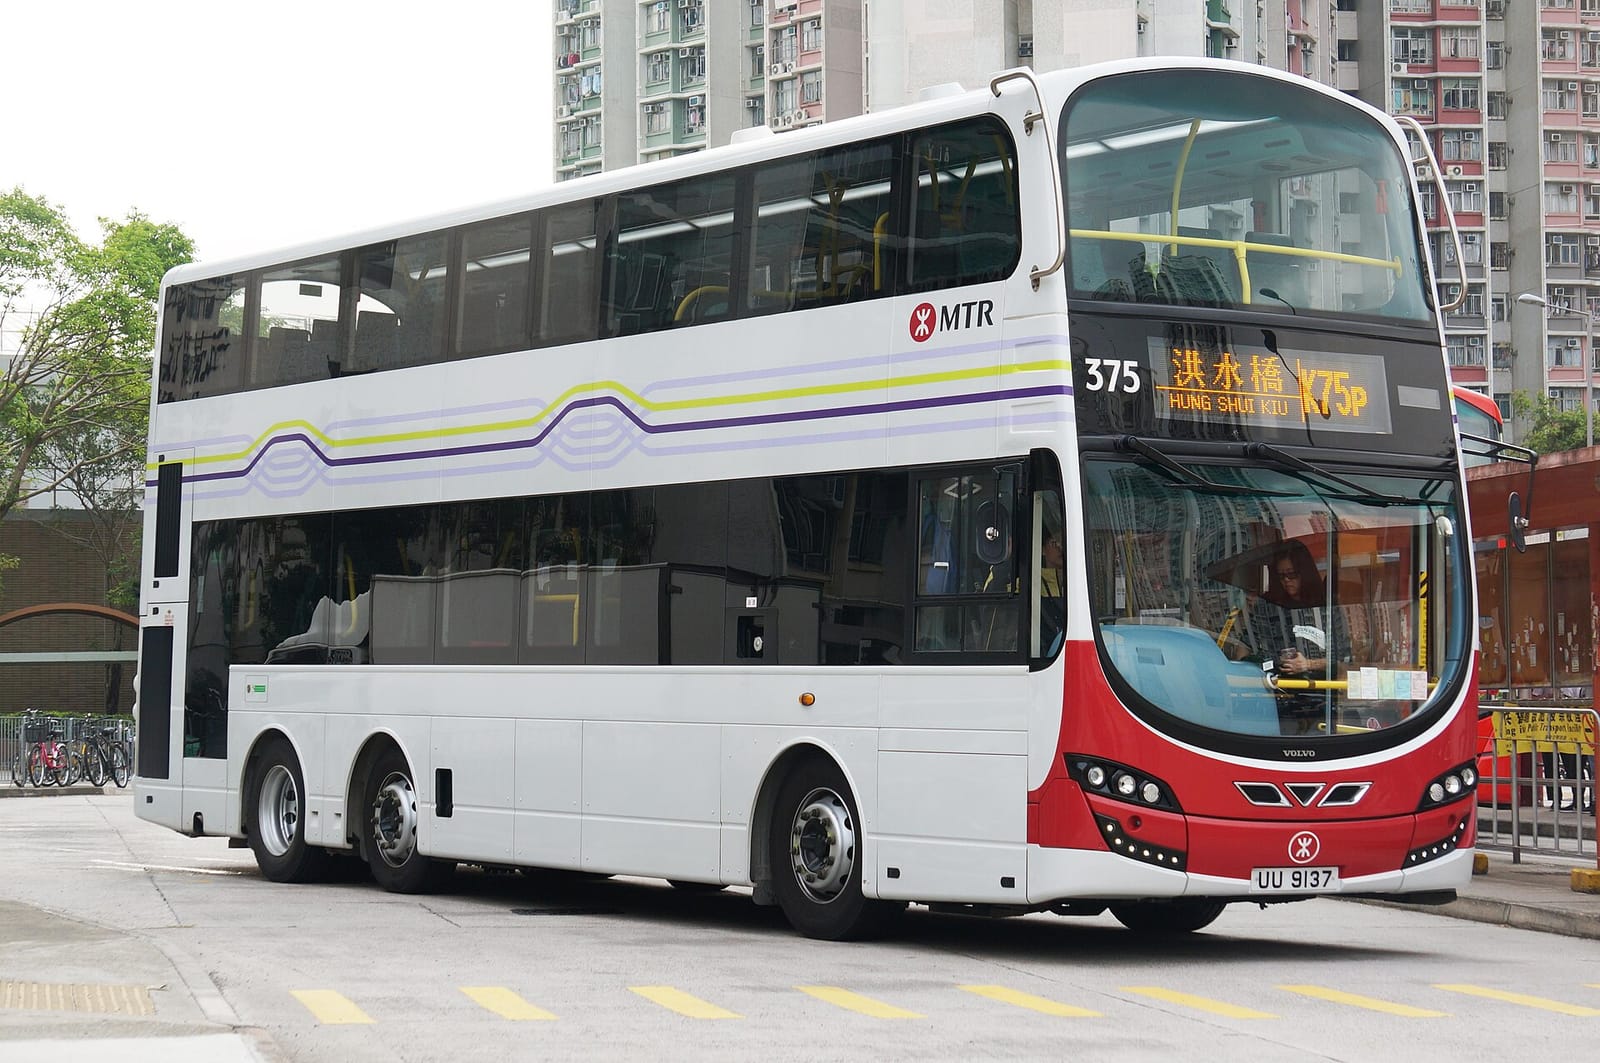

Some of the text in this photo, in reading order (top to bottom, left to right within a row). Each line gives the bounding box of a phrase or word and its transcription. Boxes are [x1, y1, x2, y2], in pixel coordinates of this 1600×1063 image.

[939, 299, 994, 331] MTR
[1085, 358, 1141, 393] 375
[1172, 348, 1283, 393] 洪水橋
[1169, 392, 1288, 416] HUNG SHUI KIU
[1258, 870, 1333, 889] UU 9137
